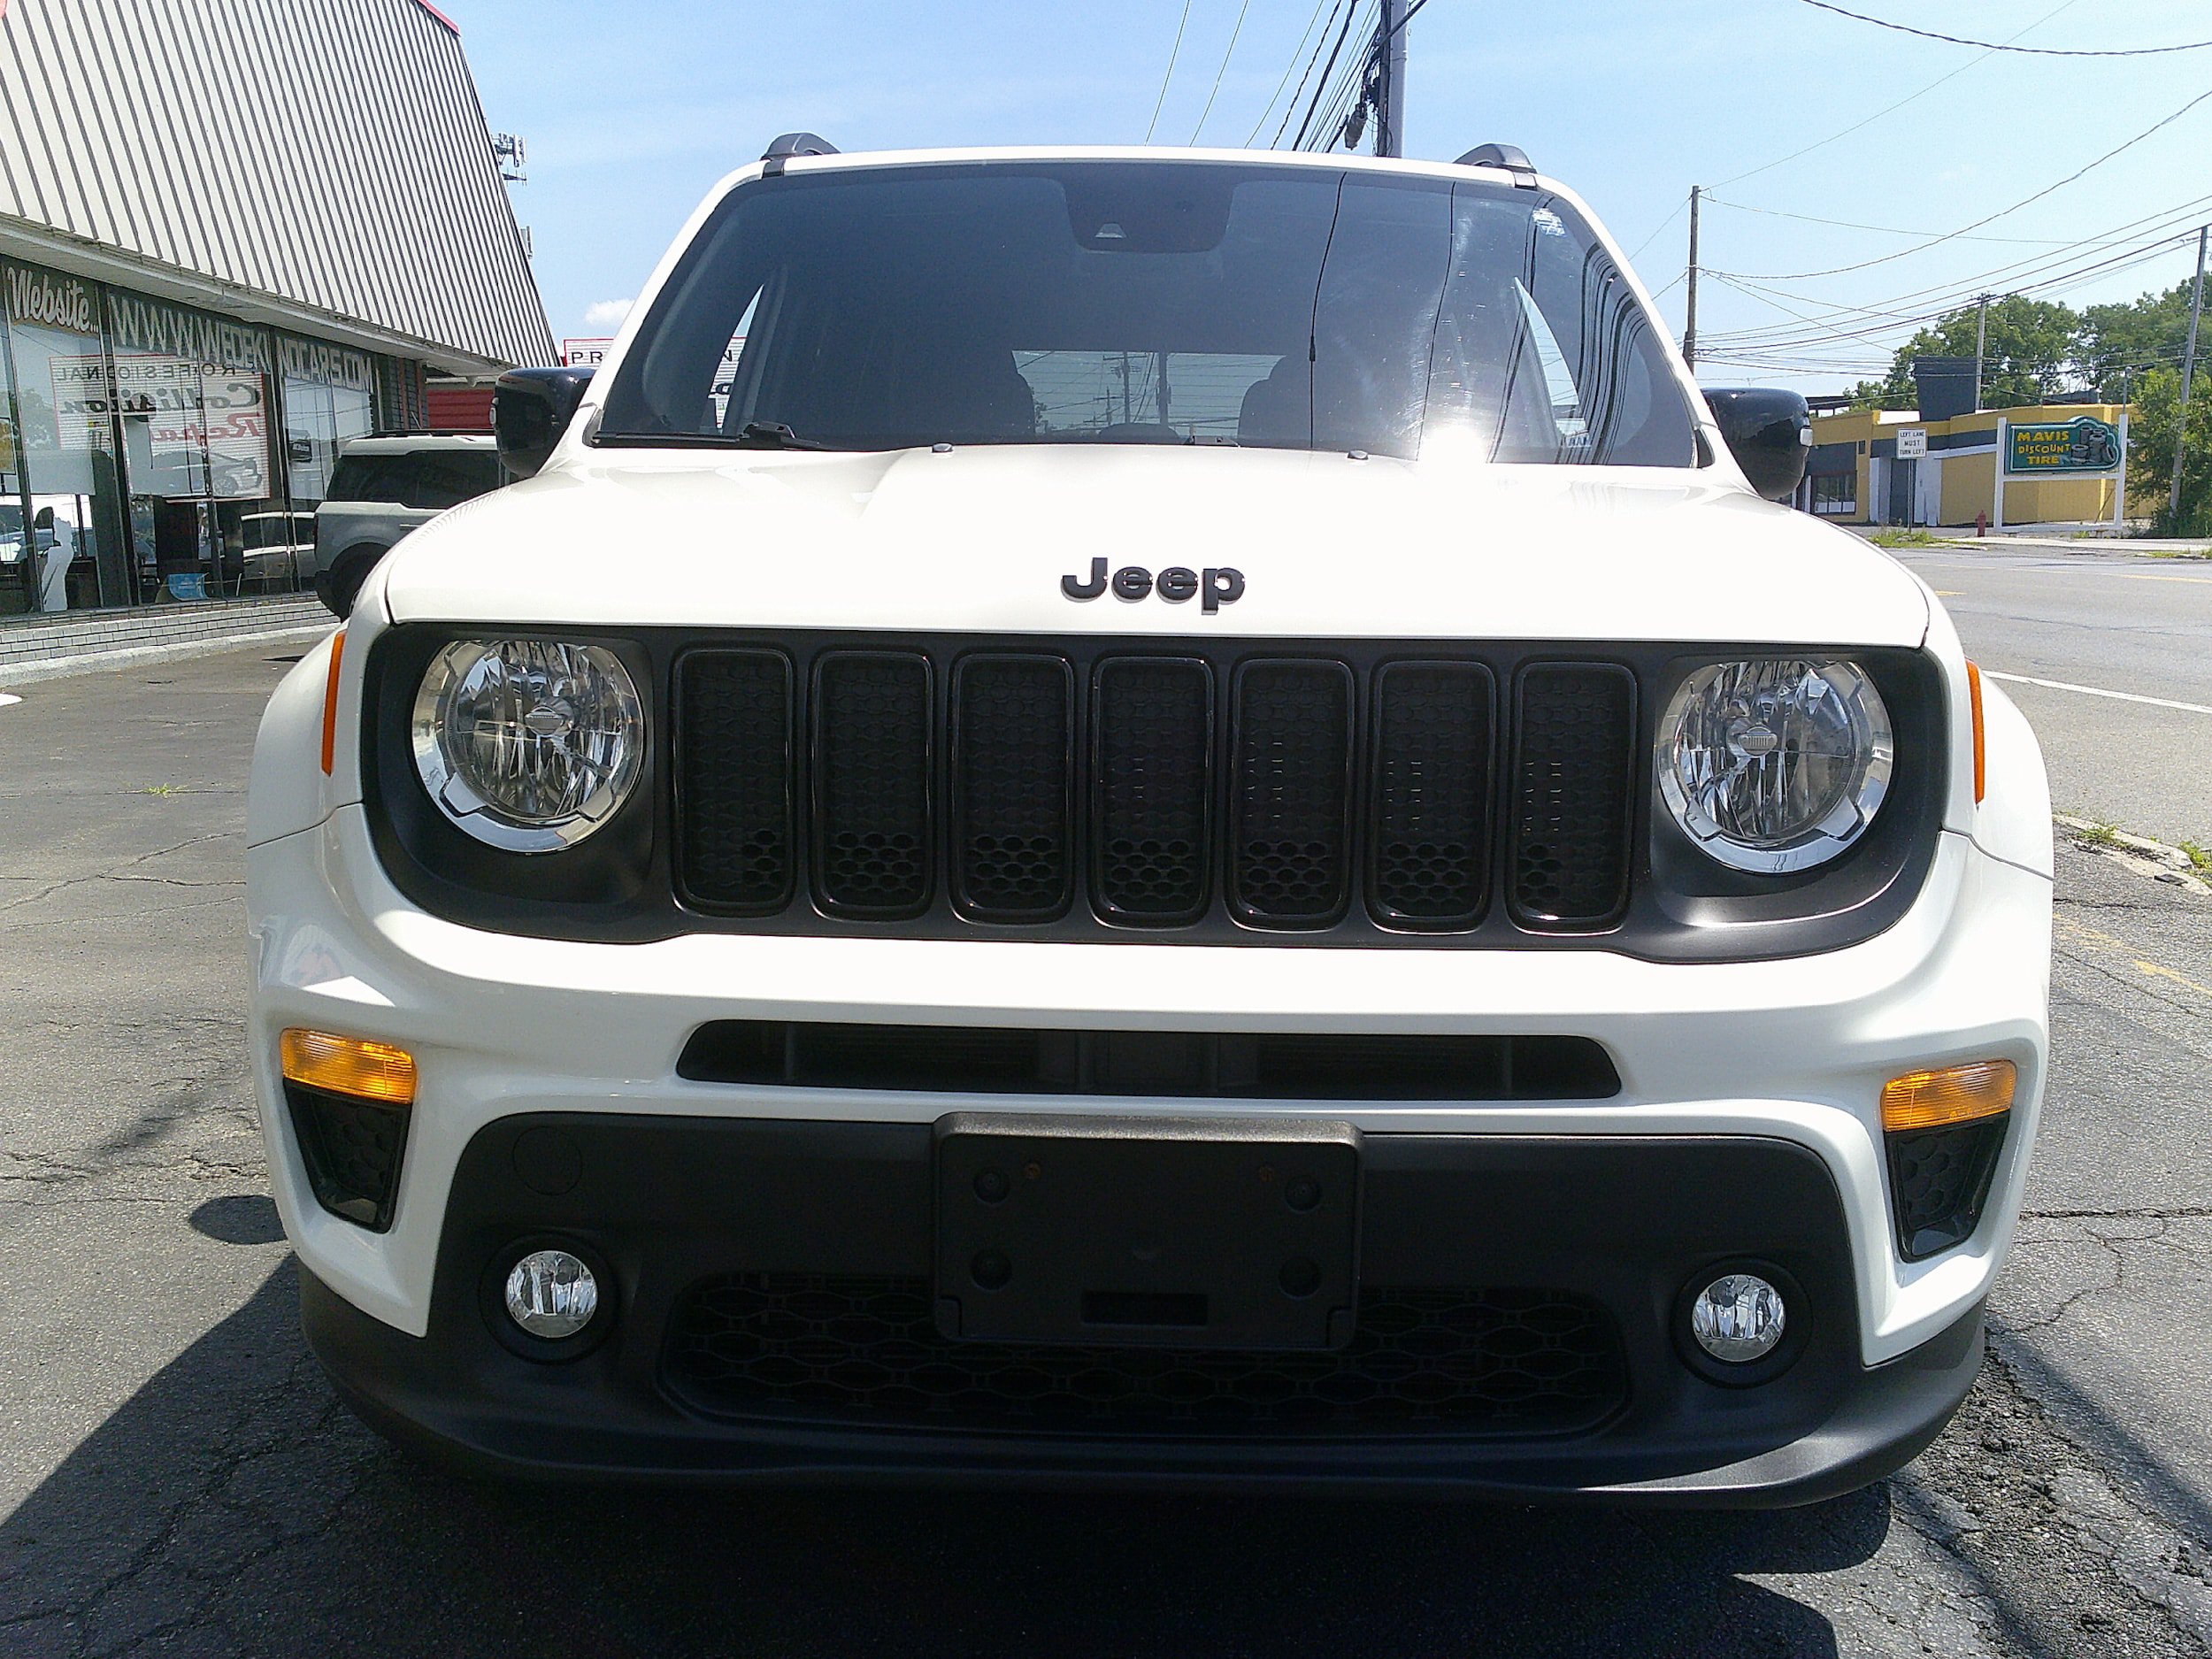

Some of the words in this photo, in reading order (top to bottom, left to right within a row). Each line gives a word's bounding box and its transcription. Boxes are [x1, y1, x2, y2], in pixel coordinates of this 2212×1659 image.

[571, 350, 603, 365] PR
[2016, 430, 2070, 442] MAVIS
[2018, 443, 2070, 454] DISCOUNT
[2026, 455, 2060, 465] TIRE
[1062, 557, 1246, 615] Jeep
